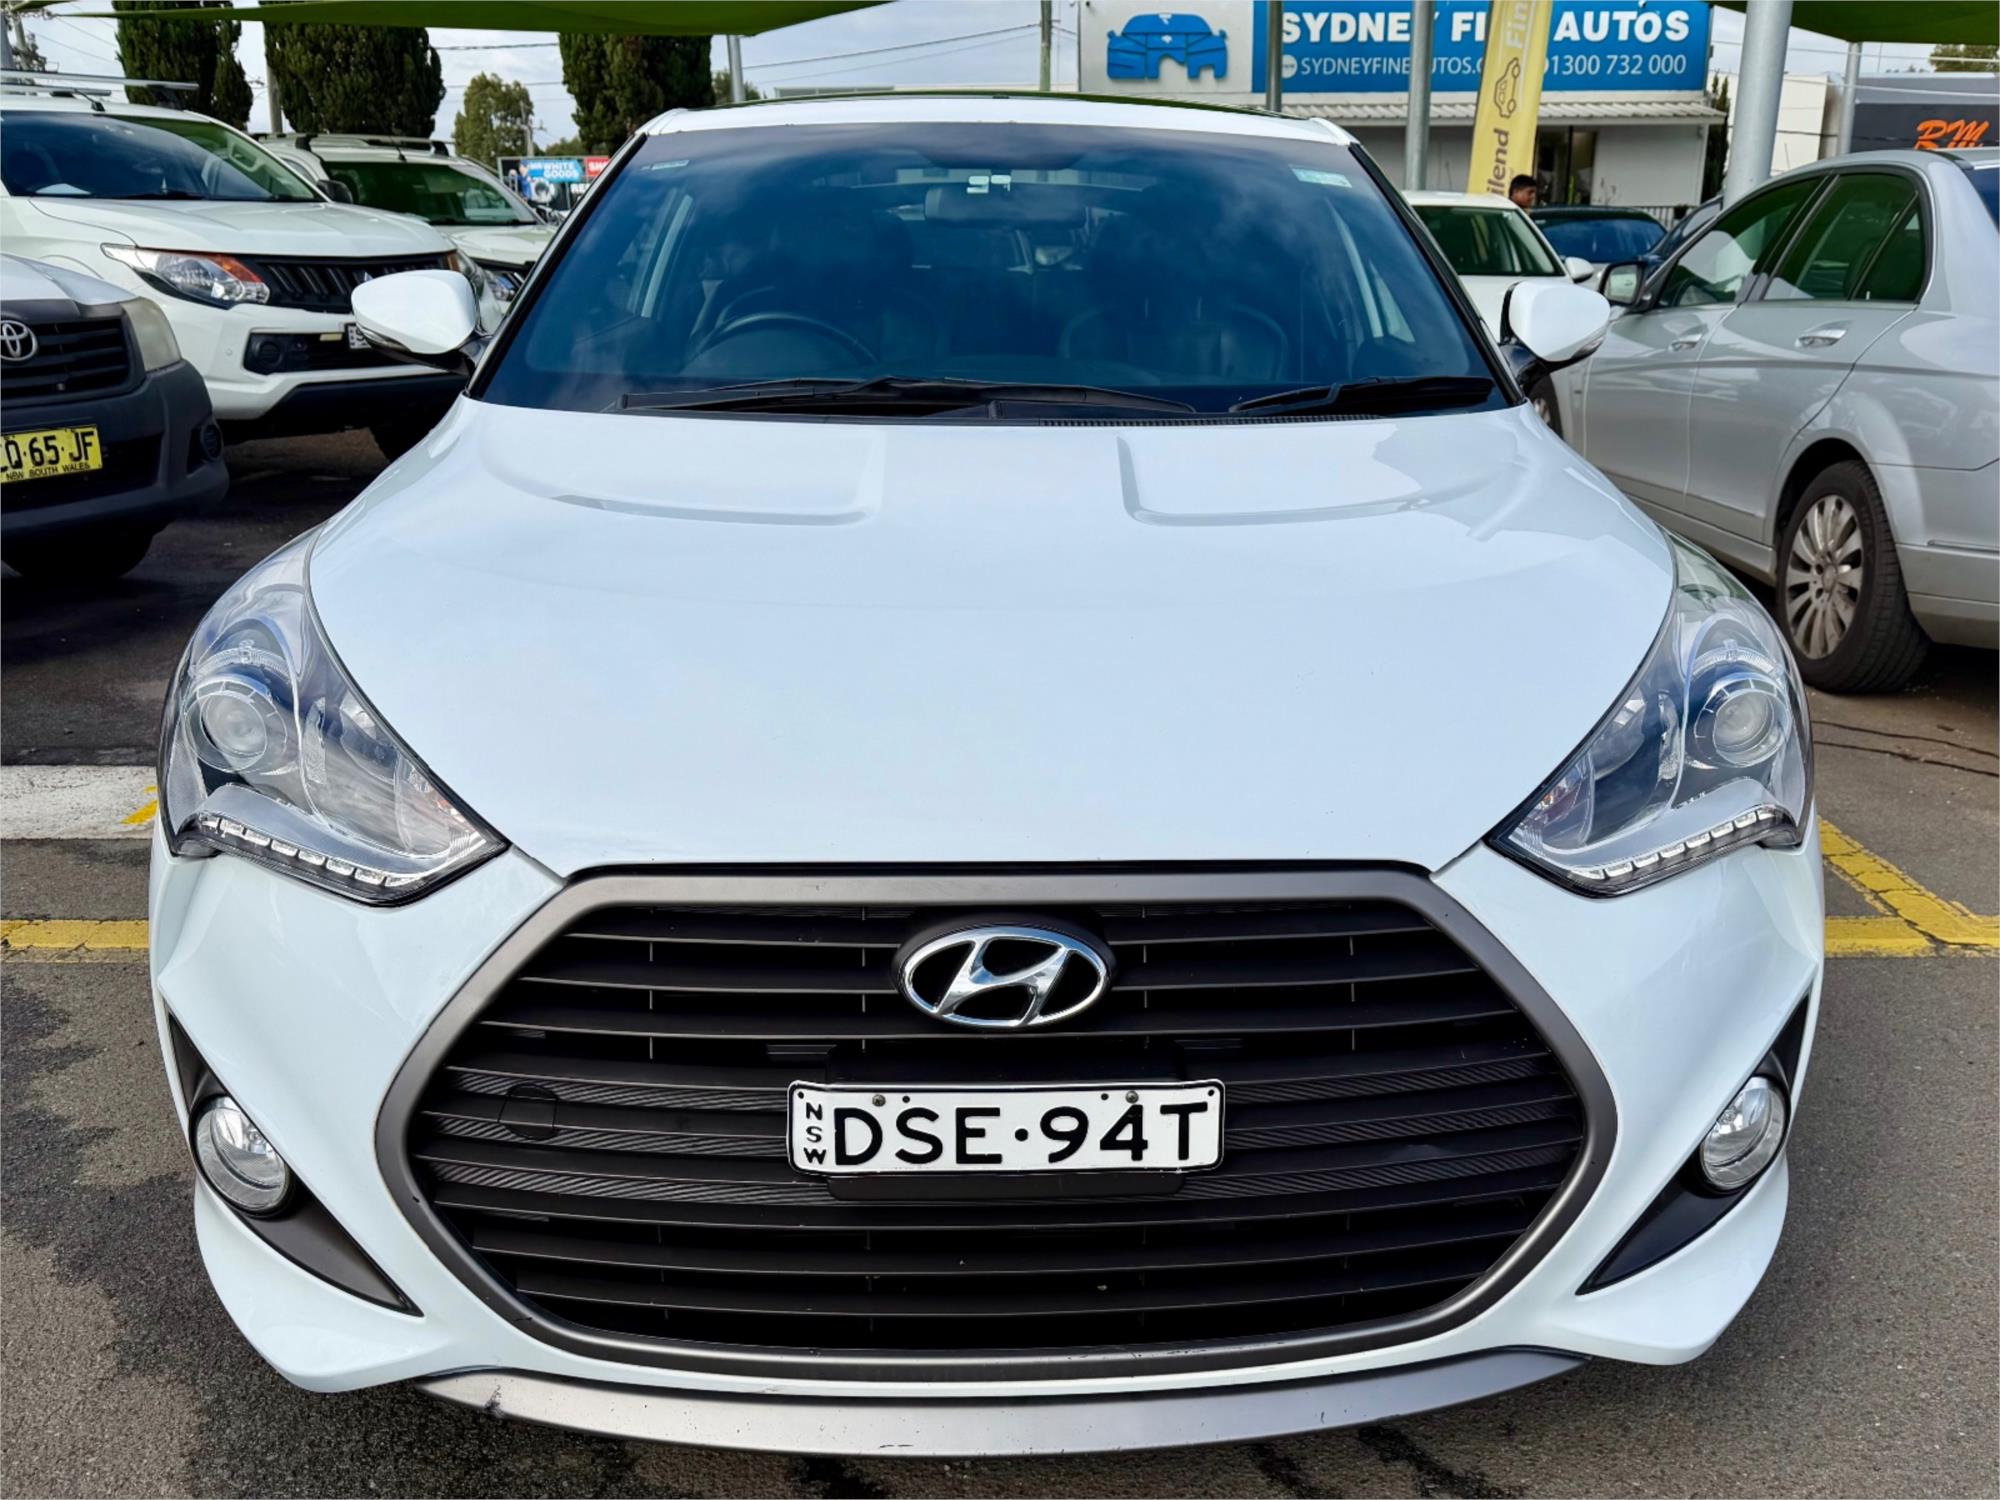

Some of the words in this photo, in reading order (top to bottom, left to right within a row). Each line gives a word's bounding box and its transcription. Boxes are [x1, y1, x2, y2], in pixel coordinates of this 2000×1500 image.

[1282, 11, 1440, 44] SYDNE
[1553, 10, 1690, 43] AUTOS
[1551, 54, 1600, 76] 1300
[1606, 54, 1642, 76] 732
[1649, 54, 1687, 76] 000
[543, 161, 576, 171] WHITE
[543, 170, 580, 179] GOODS
[29, 466, 58, 477] SOUTH
[62, 462, 90, 473] WALES
[803, 1101, 828, 1165] NSW
[833, 1101, 1208, 1166] DSE·94T
